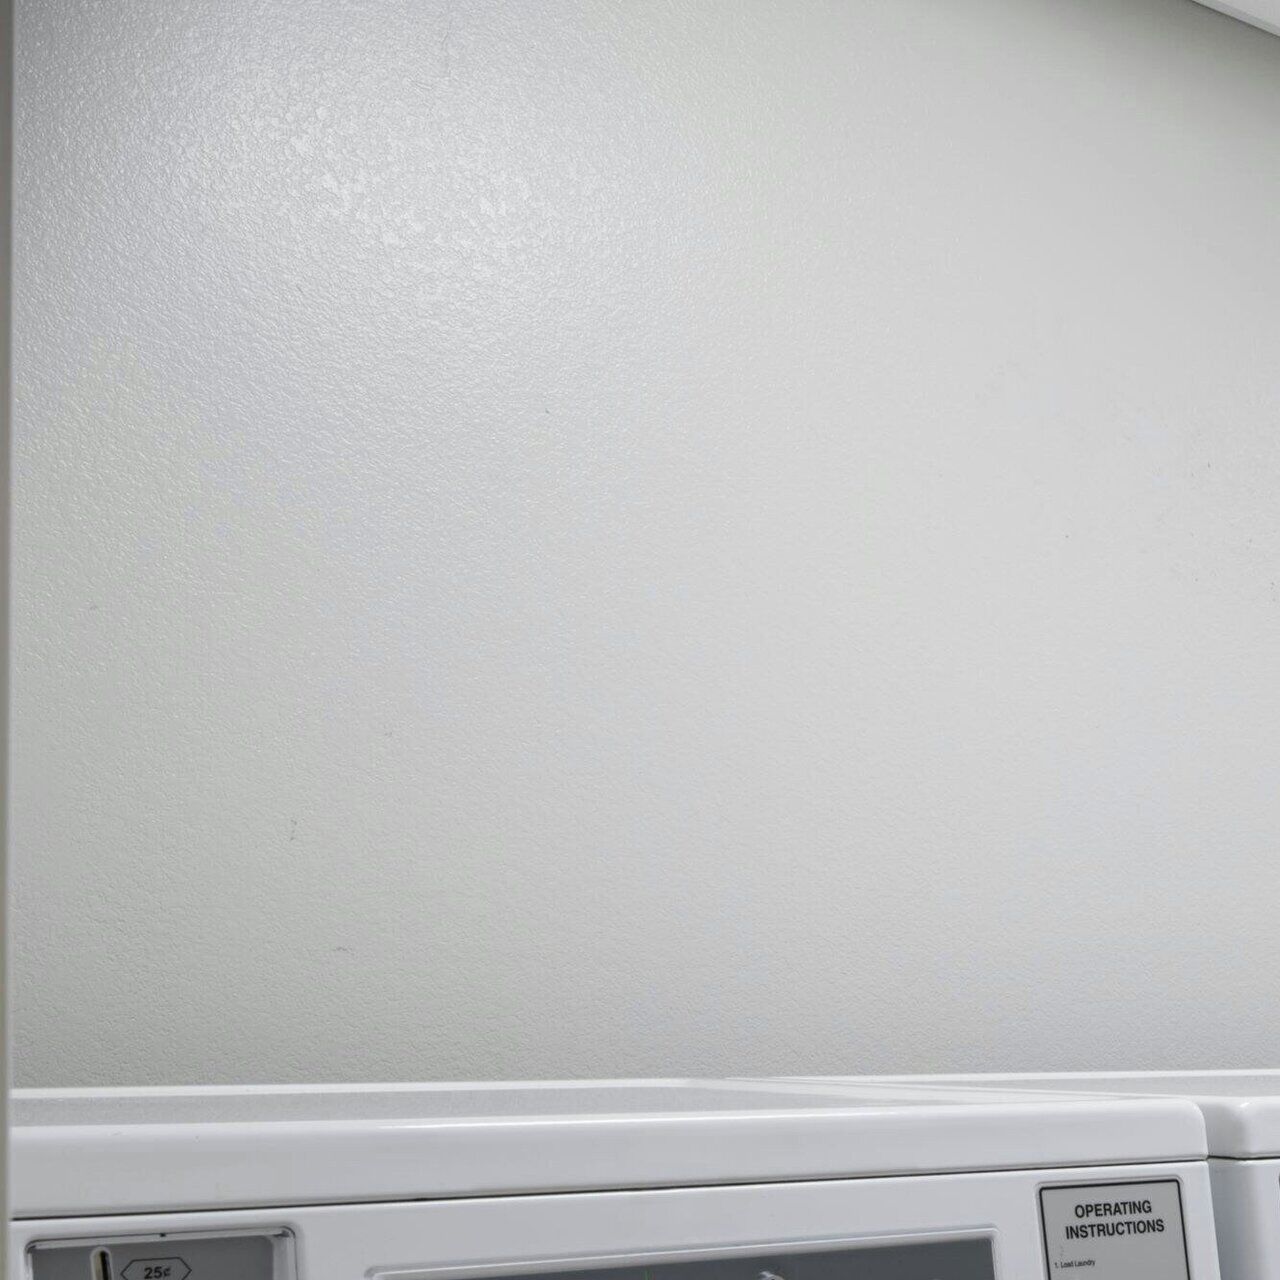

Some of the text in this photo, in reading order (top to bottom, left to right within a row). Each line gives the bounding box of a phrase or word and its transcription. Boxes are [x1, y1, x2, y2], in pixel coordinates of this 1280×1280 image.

[1075, 1200, 1152, 1218] OPERATING
[1065, 1219, 1165, 1239] INSTRUCTIONS
[1075, 1259, 1095, 1267] Laundry
[143, 1266, 171, 1280] 25¢
